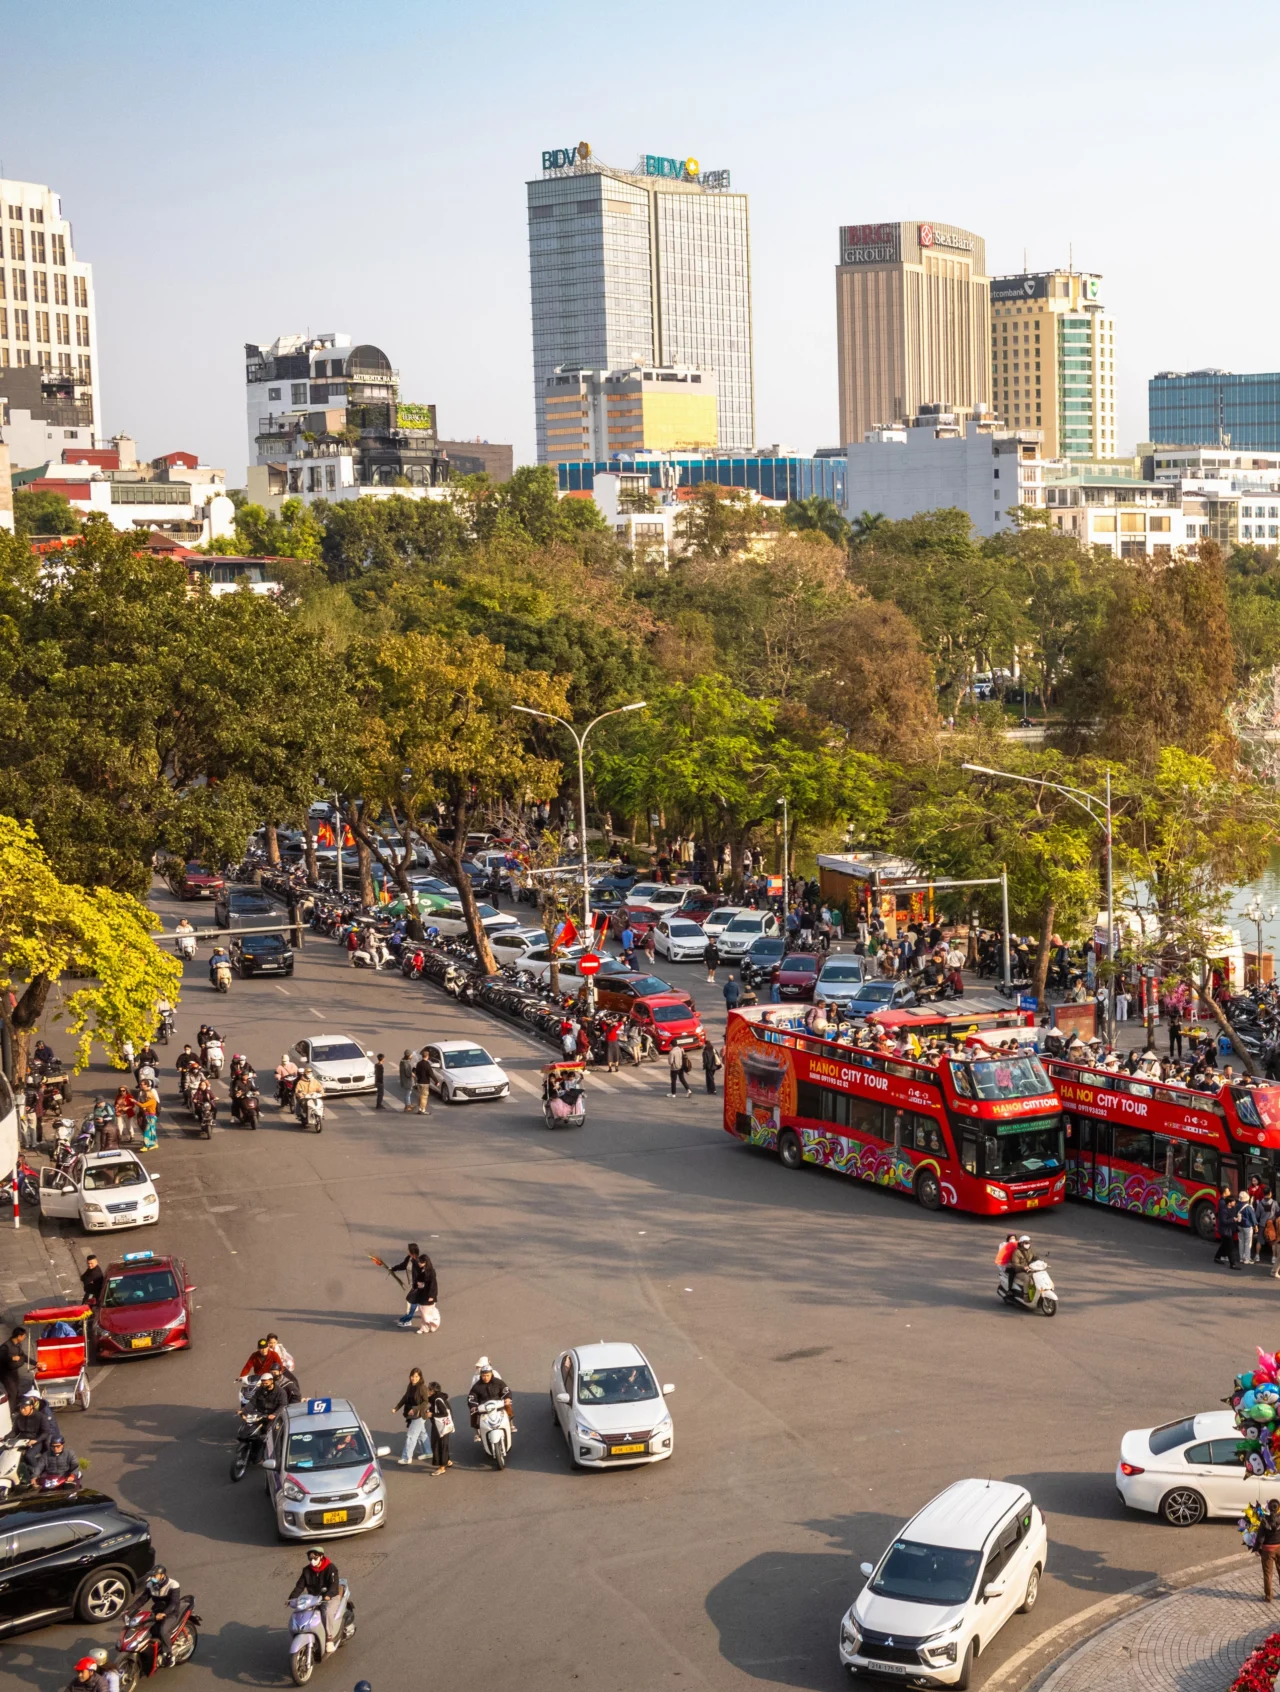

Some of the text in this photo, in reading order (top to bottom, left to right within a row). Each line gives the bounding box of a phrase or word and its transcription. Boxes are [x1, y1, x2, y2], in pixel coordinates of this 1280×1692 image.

[542, 147, 577, 170] BIDV
[646, 155, 685, 178] BIDV
[849, 223, 891, 245] BRG
[935, 231, 975, 251] SeABank
[844, 247, 894, 262] GROUP
[809, 1059, 888, 1090] HANOI CITY TOUR
[992, 1103, 1022, 1114] HANOI
[1060, 1085, 1148, 1117] HA NOI CITY TOUR
